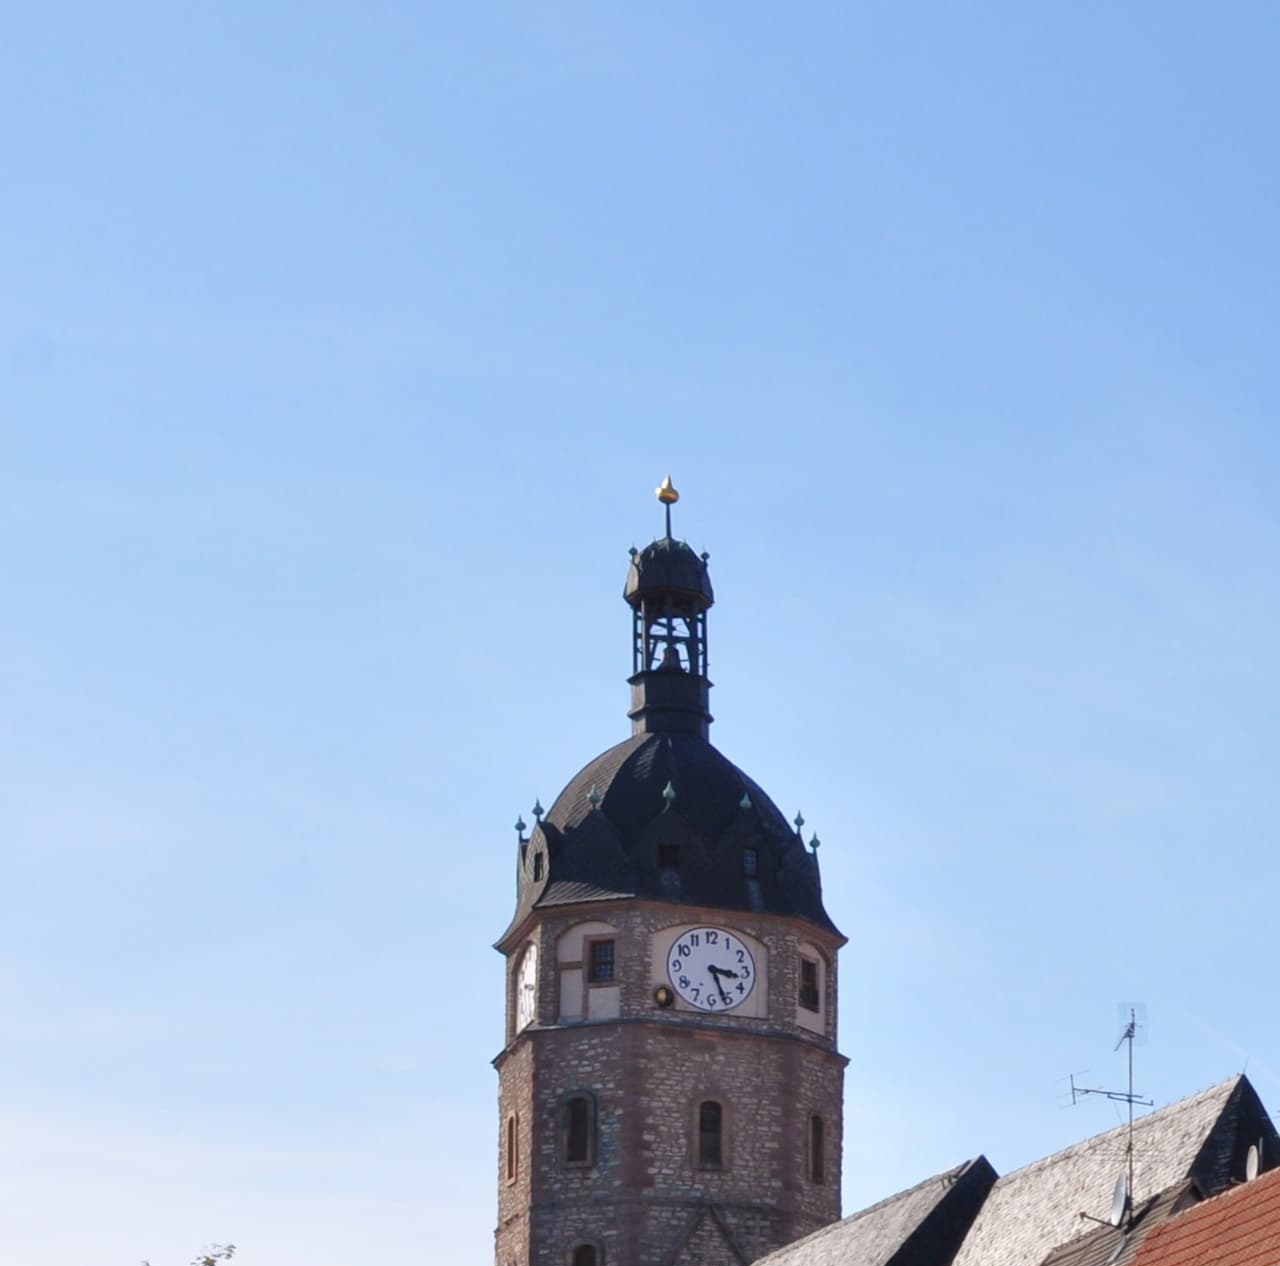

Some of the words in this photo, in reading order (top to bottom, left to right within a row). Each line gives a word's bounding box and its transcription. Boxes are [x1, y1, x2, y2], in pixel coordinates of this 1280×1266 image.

[690, 934, 699, 947] 11
[705, 931, 718, 944] 12
[725, 936, 730, 950] 1
[677, 944, 691, 957] 10
[736, 950, 744, 963] 2
[672, 959, 682, 972] 9
[741, 966, 750, 979] 3
[679, 975, 690, 989] 8
[735, 982, 745, 995] 4
[691, 988, 700, 1001] 7
[706, 993, 717, 1007] 6
[722, 992, 733, 1006] 5
